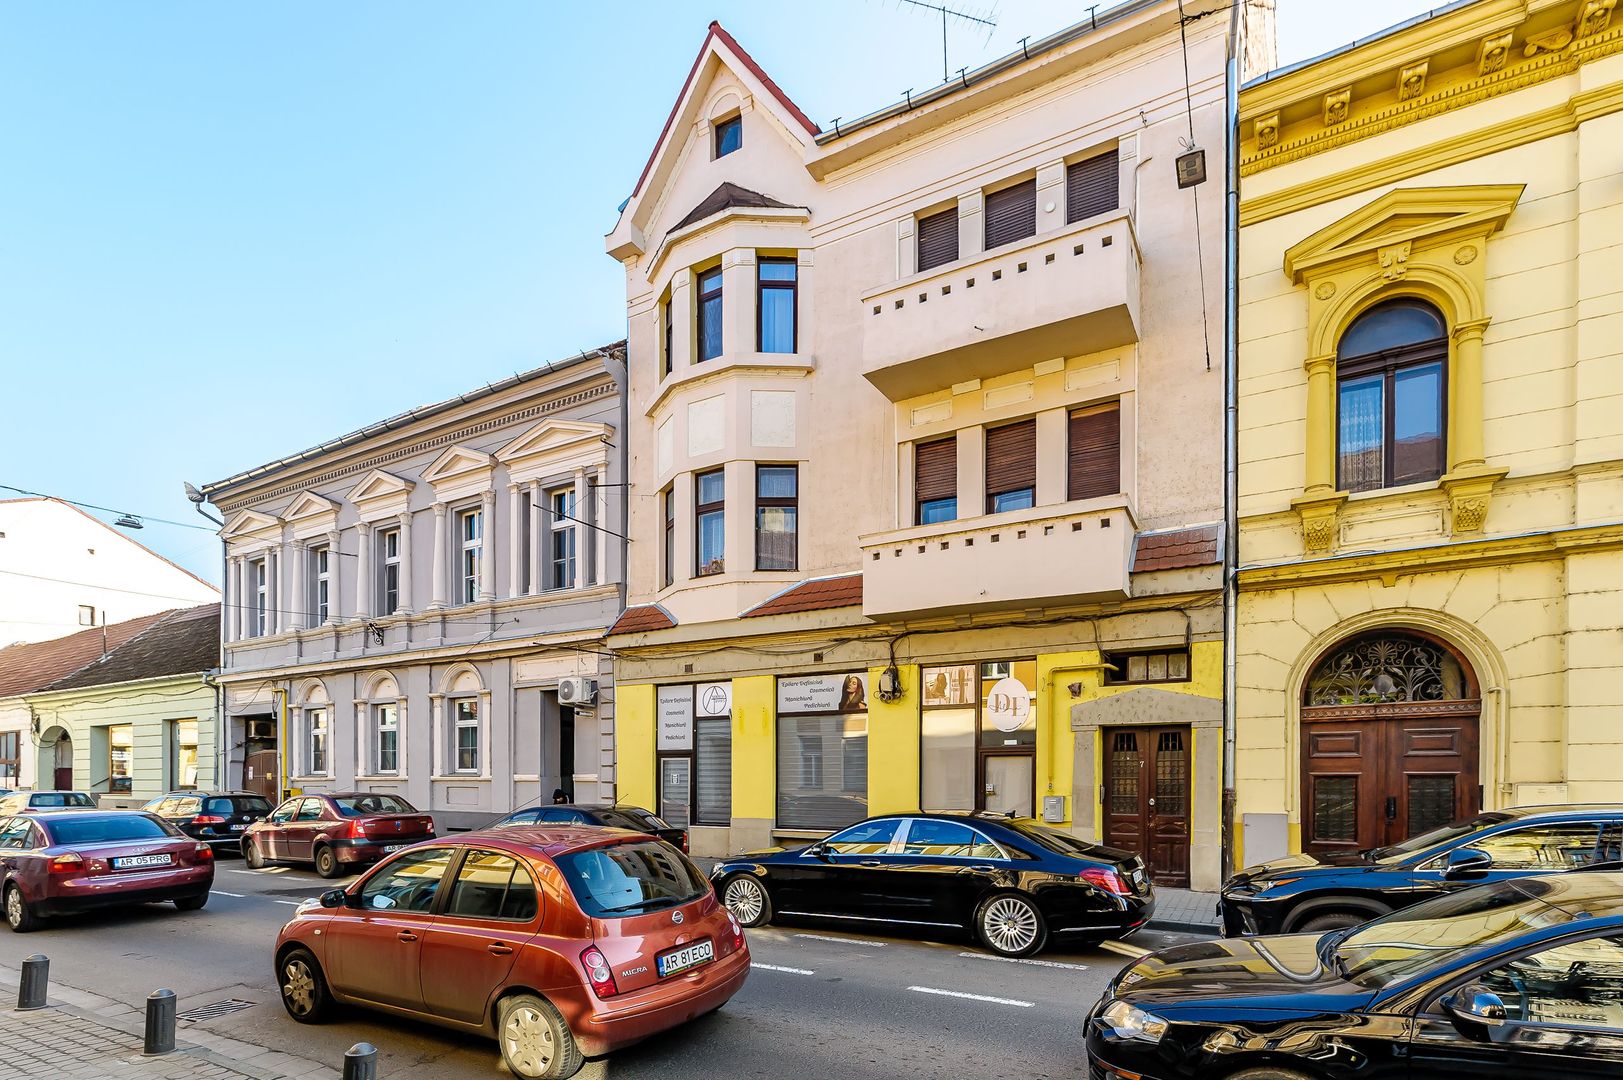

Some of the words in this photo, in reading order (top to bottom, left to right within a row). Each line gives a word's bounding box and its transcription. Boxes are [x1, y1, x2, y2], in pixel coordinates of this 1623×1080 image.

[1139, 760, 1145, 768] 7
[120, 858, 133, 866] AR
[136, 856, 149, 865] 05
[149, 855, 170, 863] PRG
[665, 954, 679, 971] AR
[680, 950, 691, 965] 81
[692, 943, 711, 960] ECO
[622, 966, 648, 976] MICRA
